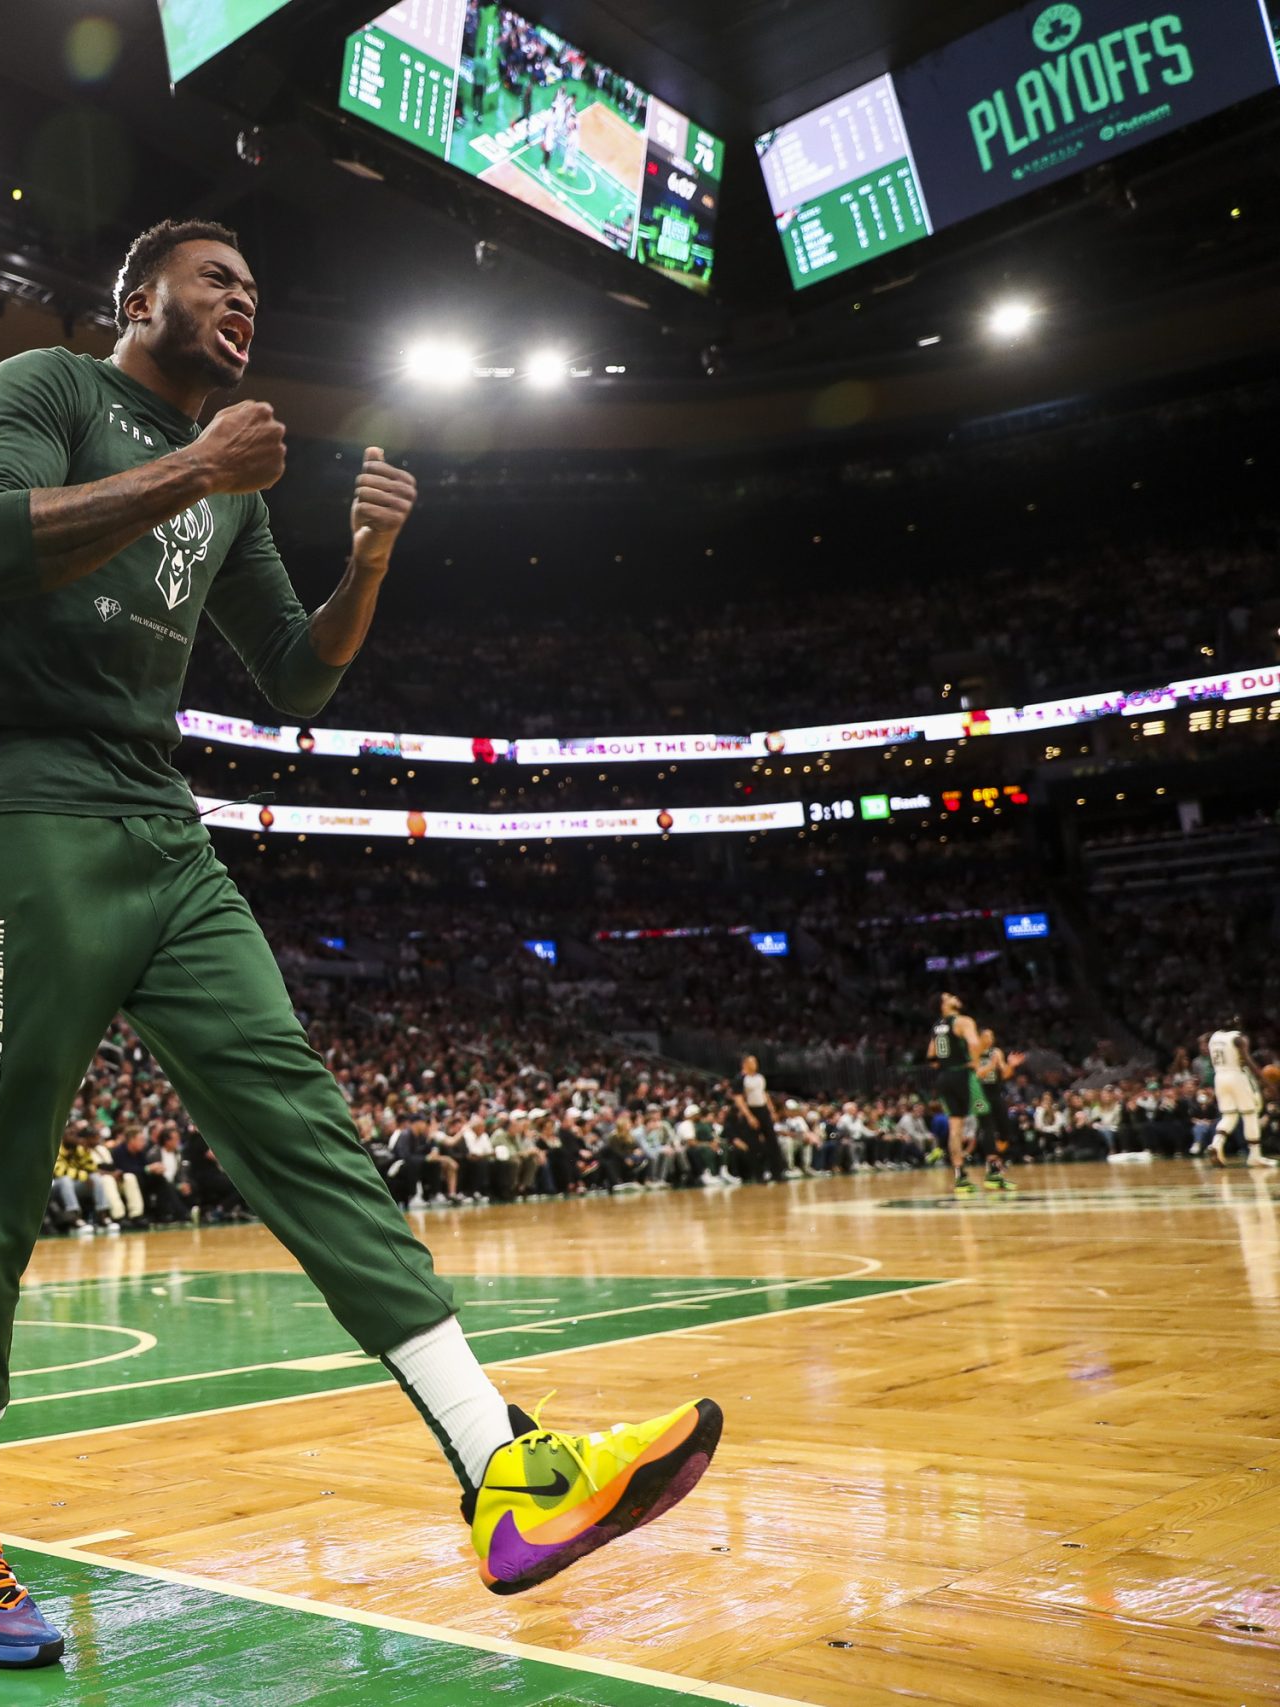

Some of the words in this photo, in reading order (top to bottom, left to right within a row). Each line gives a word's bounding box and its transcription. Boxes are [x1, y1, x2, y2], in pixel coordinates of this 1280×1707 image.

[967, 14, 1194, 172] PLAYOFFS
[109, 411, 154, 446] FEAR
[130, 613, 169, 635] MILWAUKEE
[586, 742, 645, 755] ABOUT
[655, 741, 687, 753] THE
[890, 794, 931, 811] Bank
